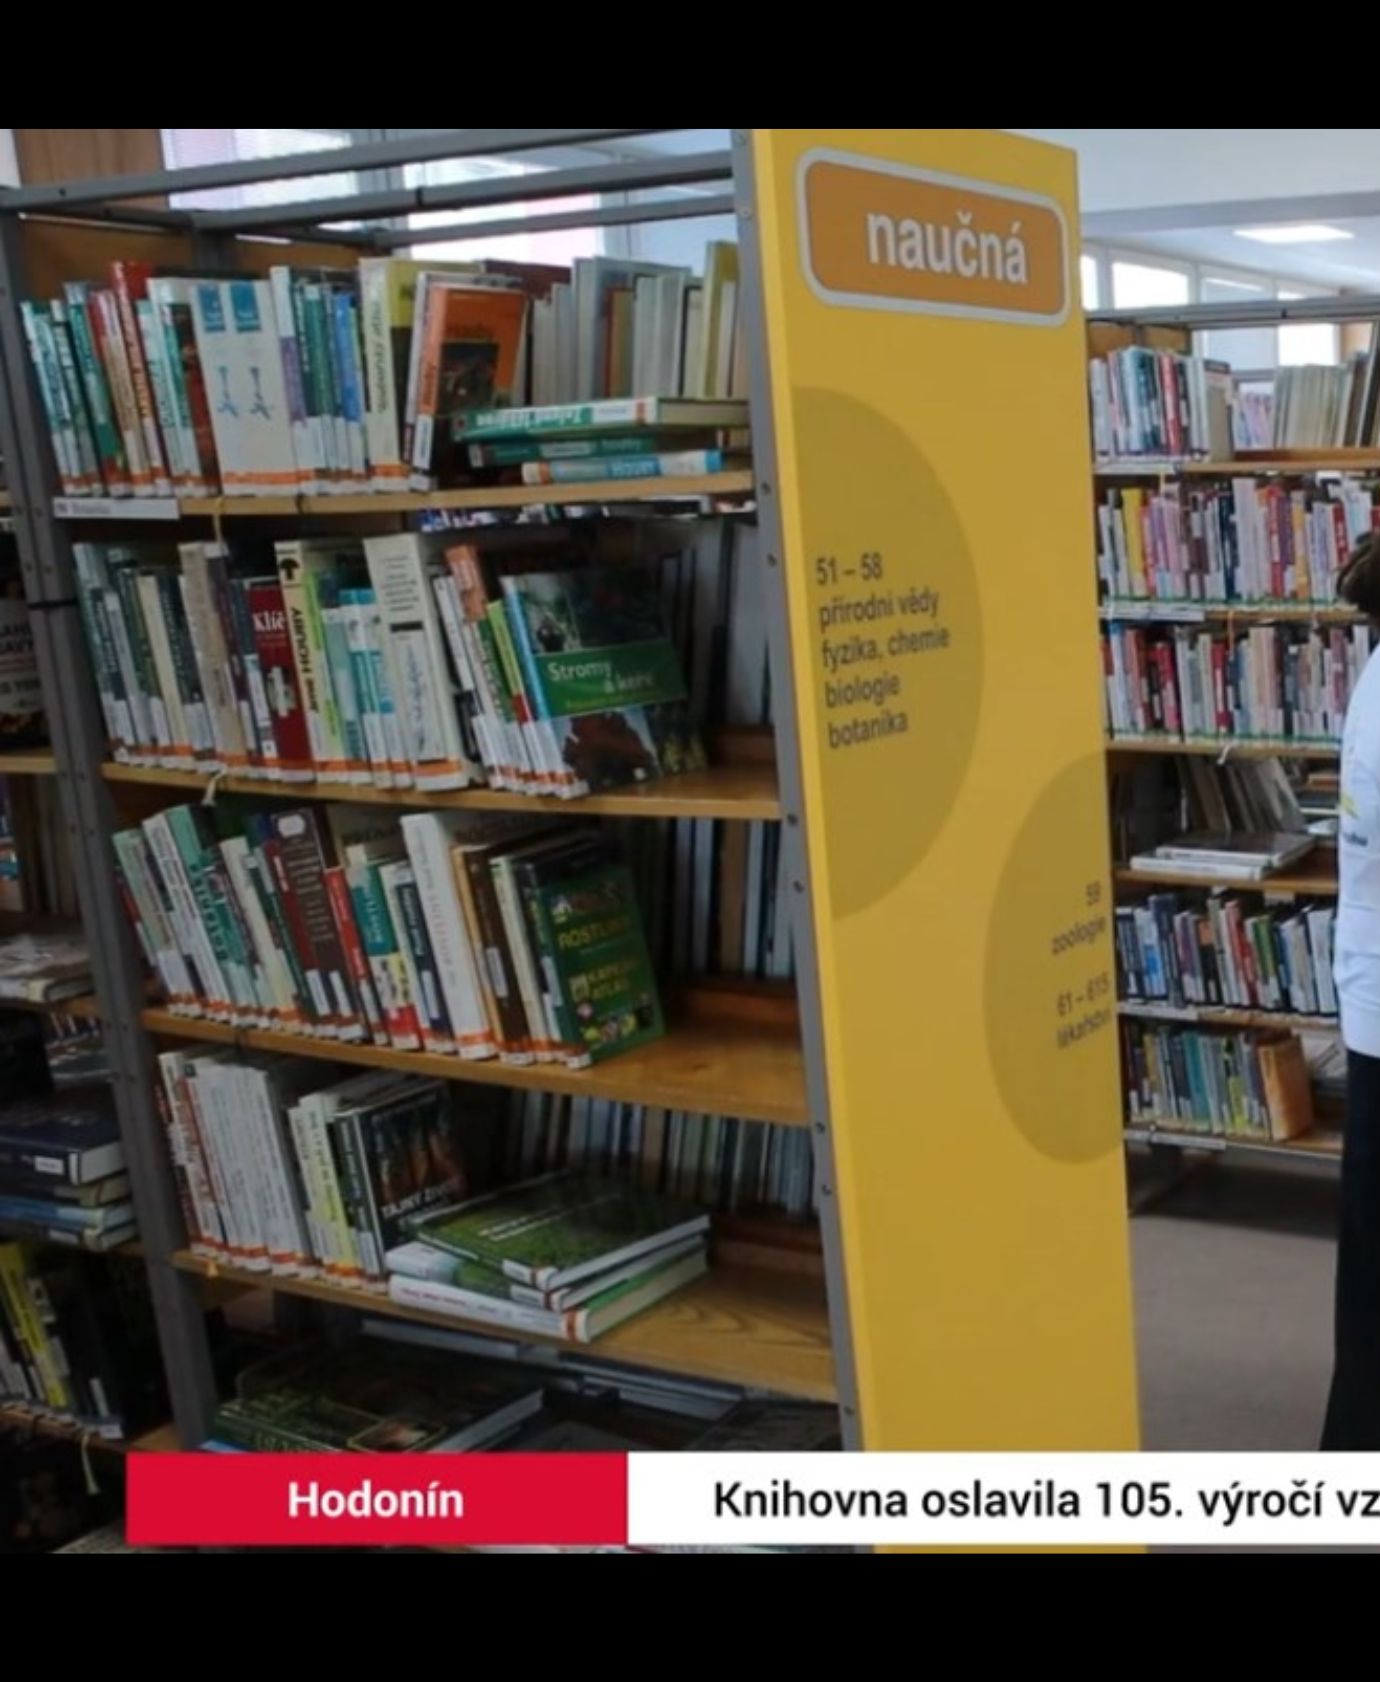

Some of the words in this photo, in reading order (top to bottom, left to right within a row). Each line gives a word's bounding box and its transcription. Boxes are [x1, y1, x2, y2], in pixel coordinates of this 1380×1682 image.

[866, 210, 1028, 284] naučná
[816, 557, 837, 585] 51
[860, 553, 882, 581] 58
[819, 591, 894, 634] přírodní
[899, 586, 939, 617] vědy
[888, 623, 950, 656] chemie
[825, 671, 900, 708] biologie
[827, 711, 908, 749] botanika
